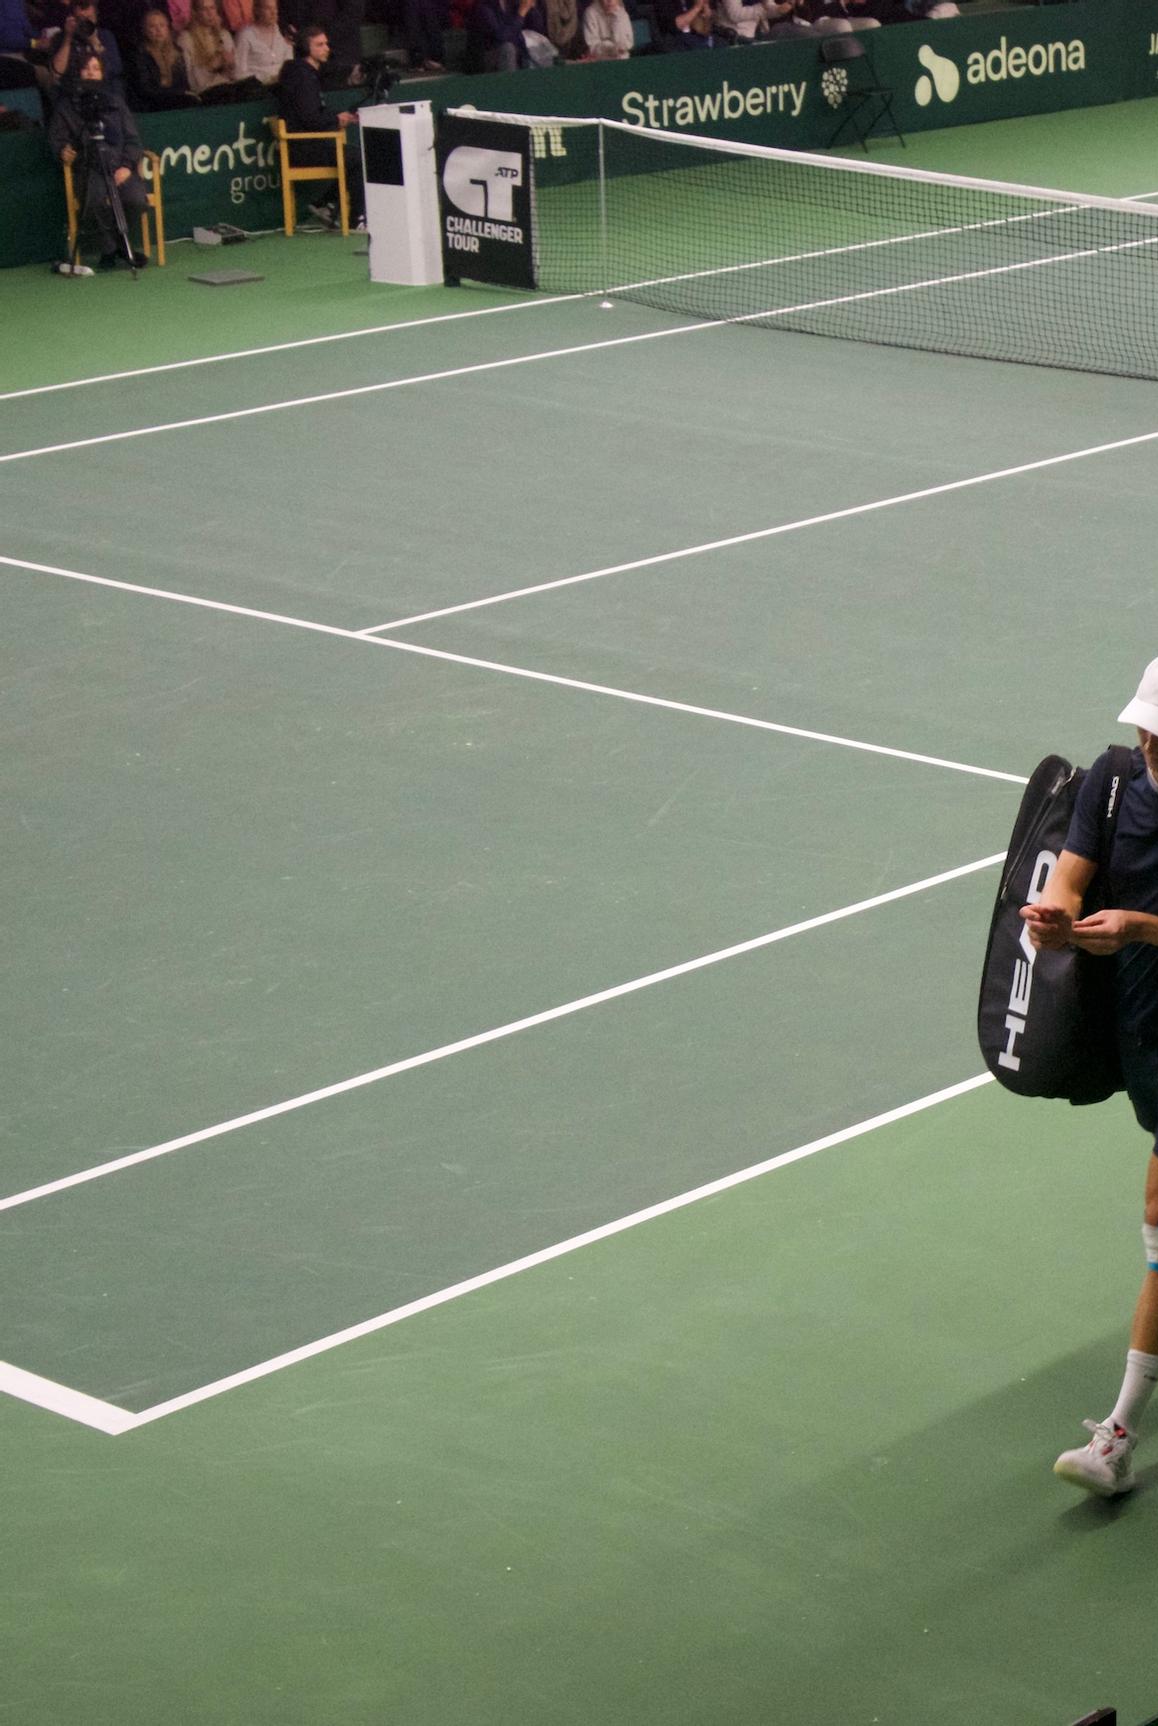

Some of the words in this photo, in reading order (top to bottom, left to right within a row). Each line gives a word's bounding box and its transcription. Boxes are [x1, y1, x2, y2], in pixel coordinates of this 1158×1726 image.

[966, 36, 1086, 84] adeona
[621, 80, 807, 128] Strawberry
[494, 166, 519, 179] ATP
[230, 173, 281, 204] grou
[446, 215, 524, 245] CHALLENGER
[446, 232, 480, 254] TOUR
